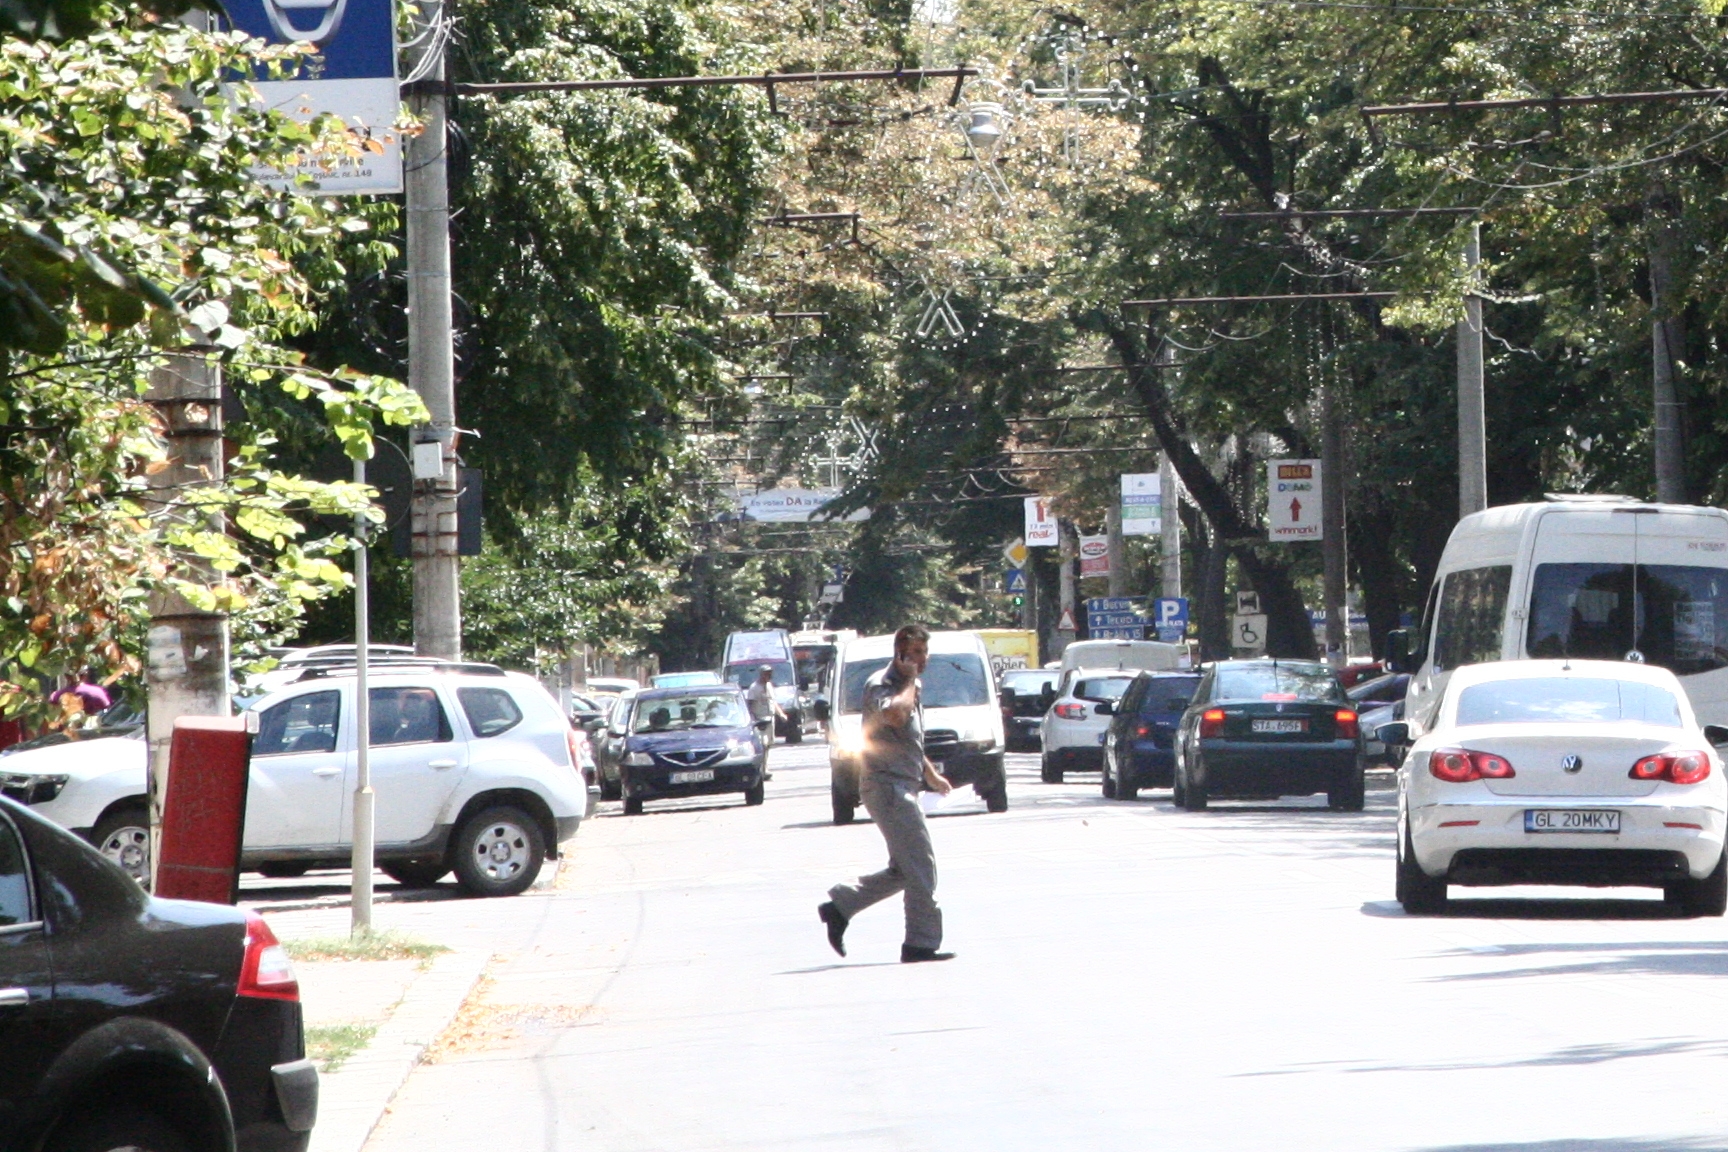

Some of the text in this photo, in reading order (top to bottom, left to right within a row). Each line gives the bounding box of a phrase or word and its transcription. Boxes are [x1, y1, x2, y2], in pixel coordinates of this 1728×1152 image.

[786, 497, 802, 506] DA
[1535, 812, 1616, 827] GL 20MKY
